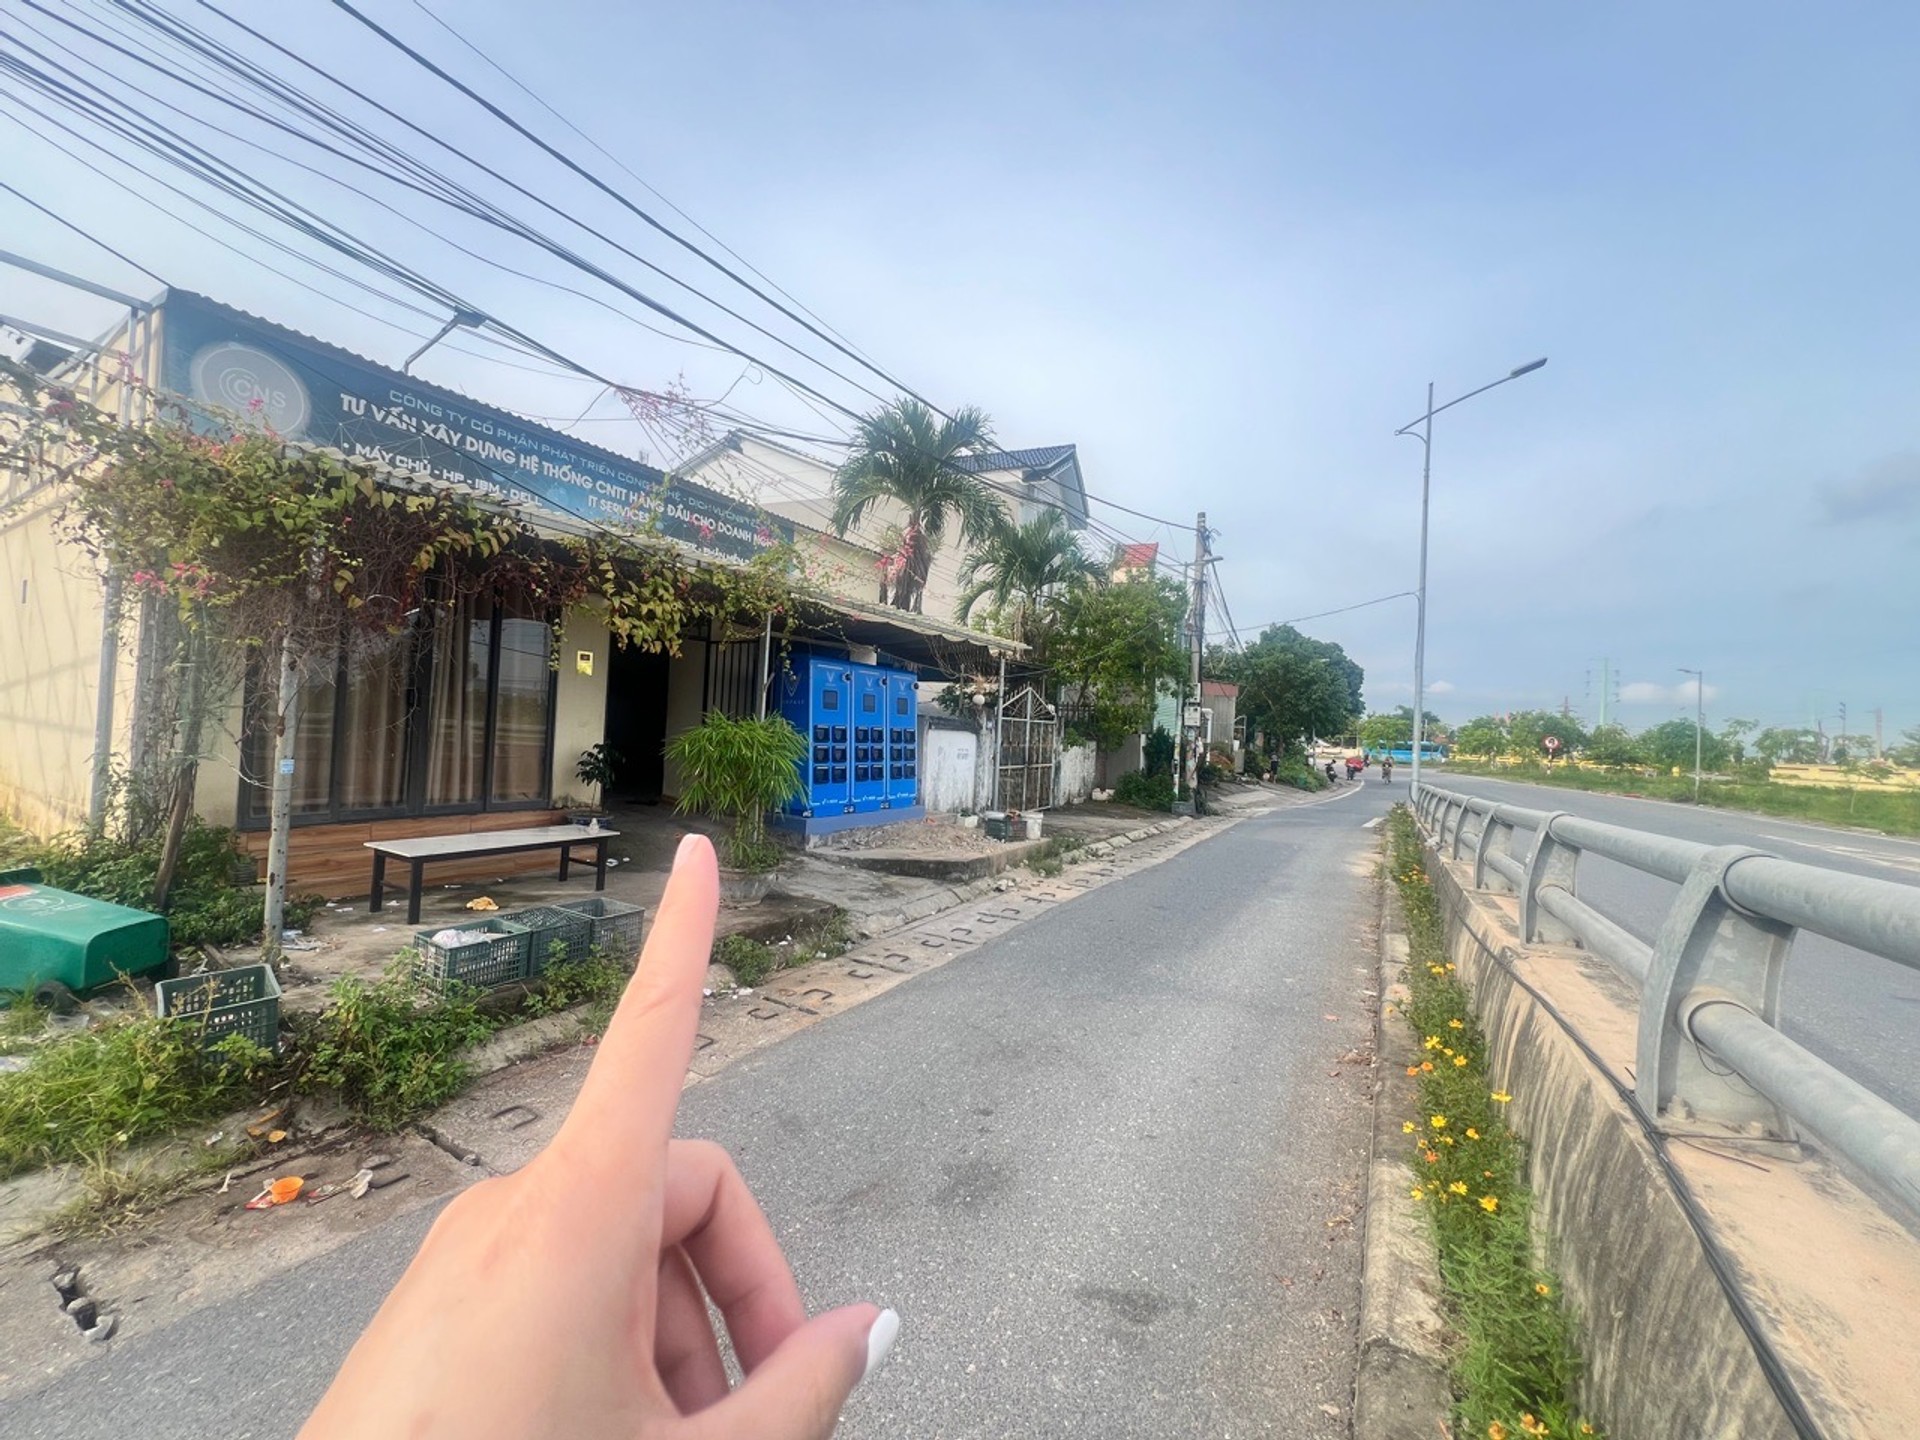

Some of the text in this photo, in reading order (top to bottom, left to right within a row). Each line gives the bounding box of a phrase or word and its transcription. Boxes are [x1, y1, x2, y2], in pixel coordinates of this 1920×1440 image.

[446, 409, 468, 425] TY
[340, 392, 367, 416] TƯ
[371, 403, 417, 433] VẤN
[421, 419, 462, 447] XÂY
[465, 435, 516, 465] DỰNG
[519, 453, 540, 475] HỆ
[542, 460, 594, 490] THỐNG
[629, 490, 665, 513] HÀNG
[693, 513, 716, 531] CHO
[717, 521, 752, 542] DOANH
[355, 442, 394, 463] MÁY
[395, 455, 432, 474] CHỦ
[442, 469, 465, 483] HP
[475, 478, 501, 495] IBM
[510, 489, 543, 507] DELL
[588, 495, 650, 524] IT SERVICES
